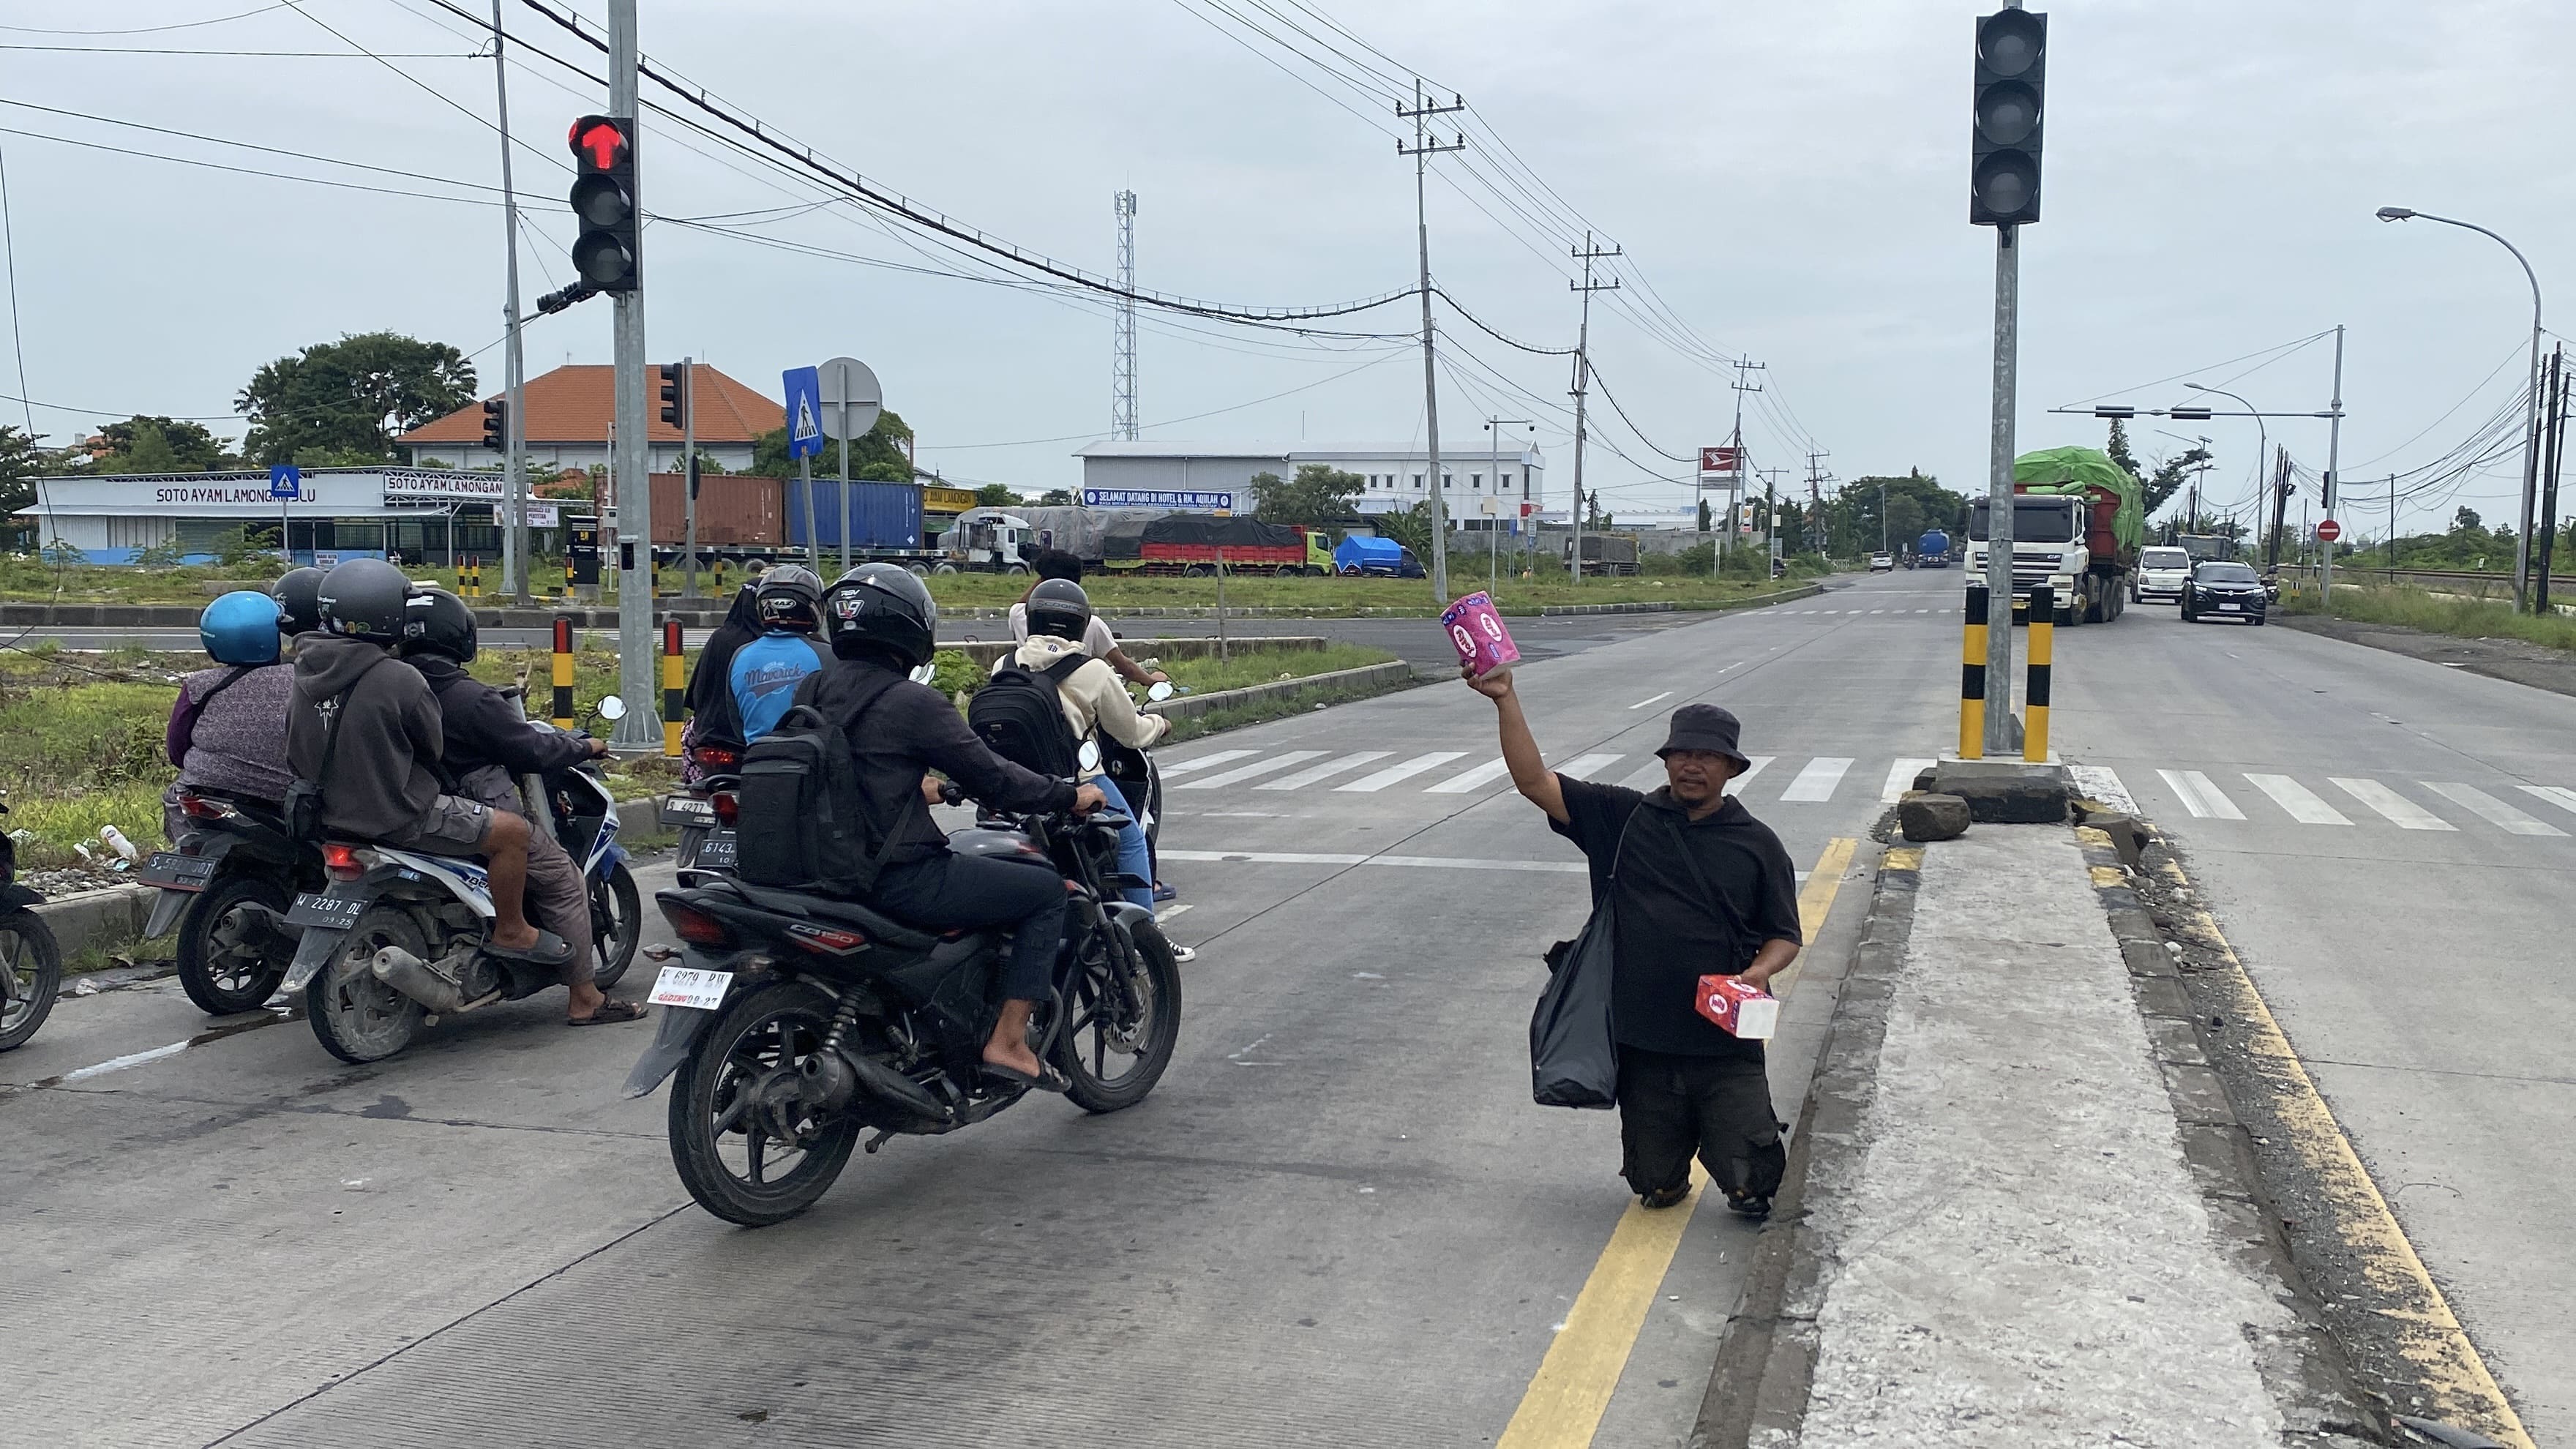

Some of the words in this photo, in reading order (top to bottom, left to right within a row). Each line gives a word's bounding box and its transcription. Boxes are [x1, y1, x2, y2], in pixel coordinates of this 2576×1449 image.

[389, 477, 417, 489] SOTO
[419, 479, 446, 492] AYAM
[449, 479, 502, 494] LAMONGAN
[157, 488, 188, 502] SOTO
[191, 489, 222, 502] AYAM
[225, 489, 289, 502] LAMONG
[291, 489, 315, 502] LU
[1099, 491, 1126, 502] SELAMAT
[1127, 492, 1149, 503] DATANG
[1150, 493, 1157, 503] DI
[1158, 493, 1177, 503] HOTEL
[1177, 493, 1183, 503] &
[705, 842, 733, 853] 6143
[151, 855, 160, 867] S
[310, 897, 343, 912] 2287
